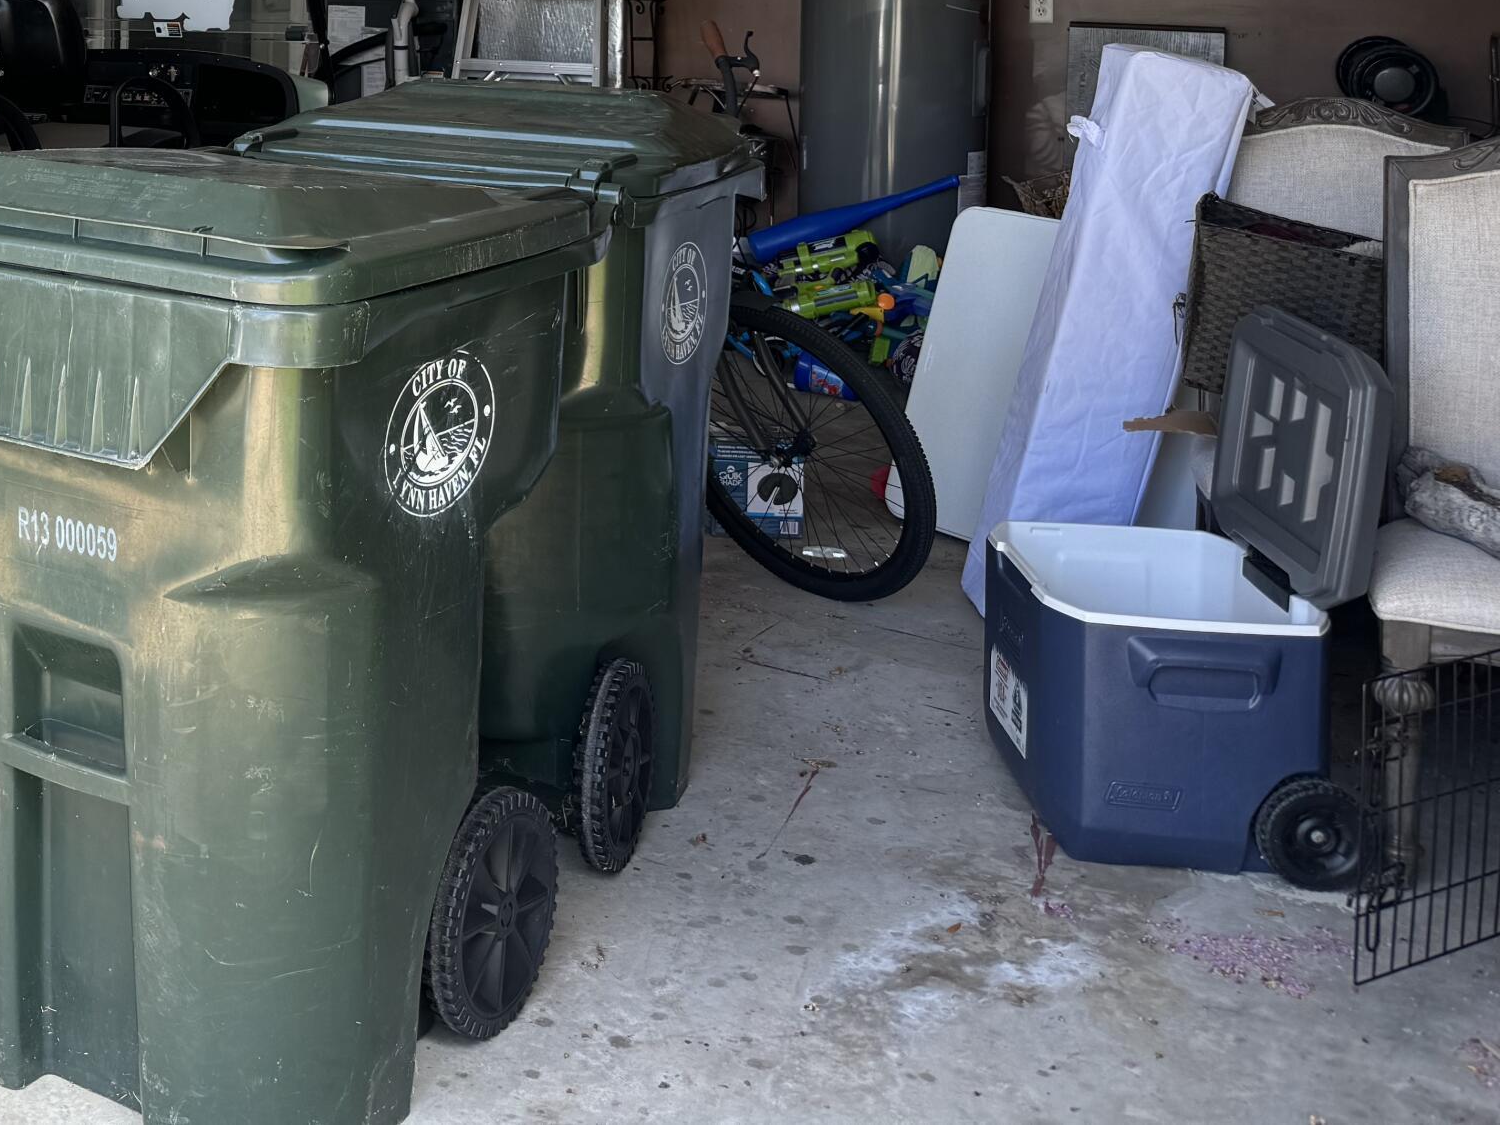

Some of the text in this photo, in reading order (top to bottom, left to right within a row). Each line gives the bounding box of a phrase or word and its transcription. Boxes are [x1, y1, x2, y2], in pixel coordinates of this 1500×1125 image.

[412, 358, 467, 397] CITY OF
[469, 436, 487, 468] FL
[18, 506, 118, 562] R13 000059
